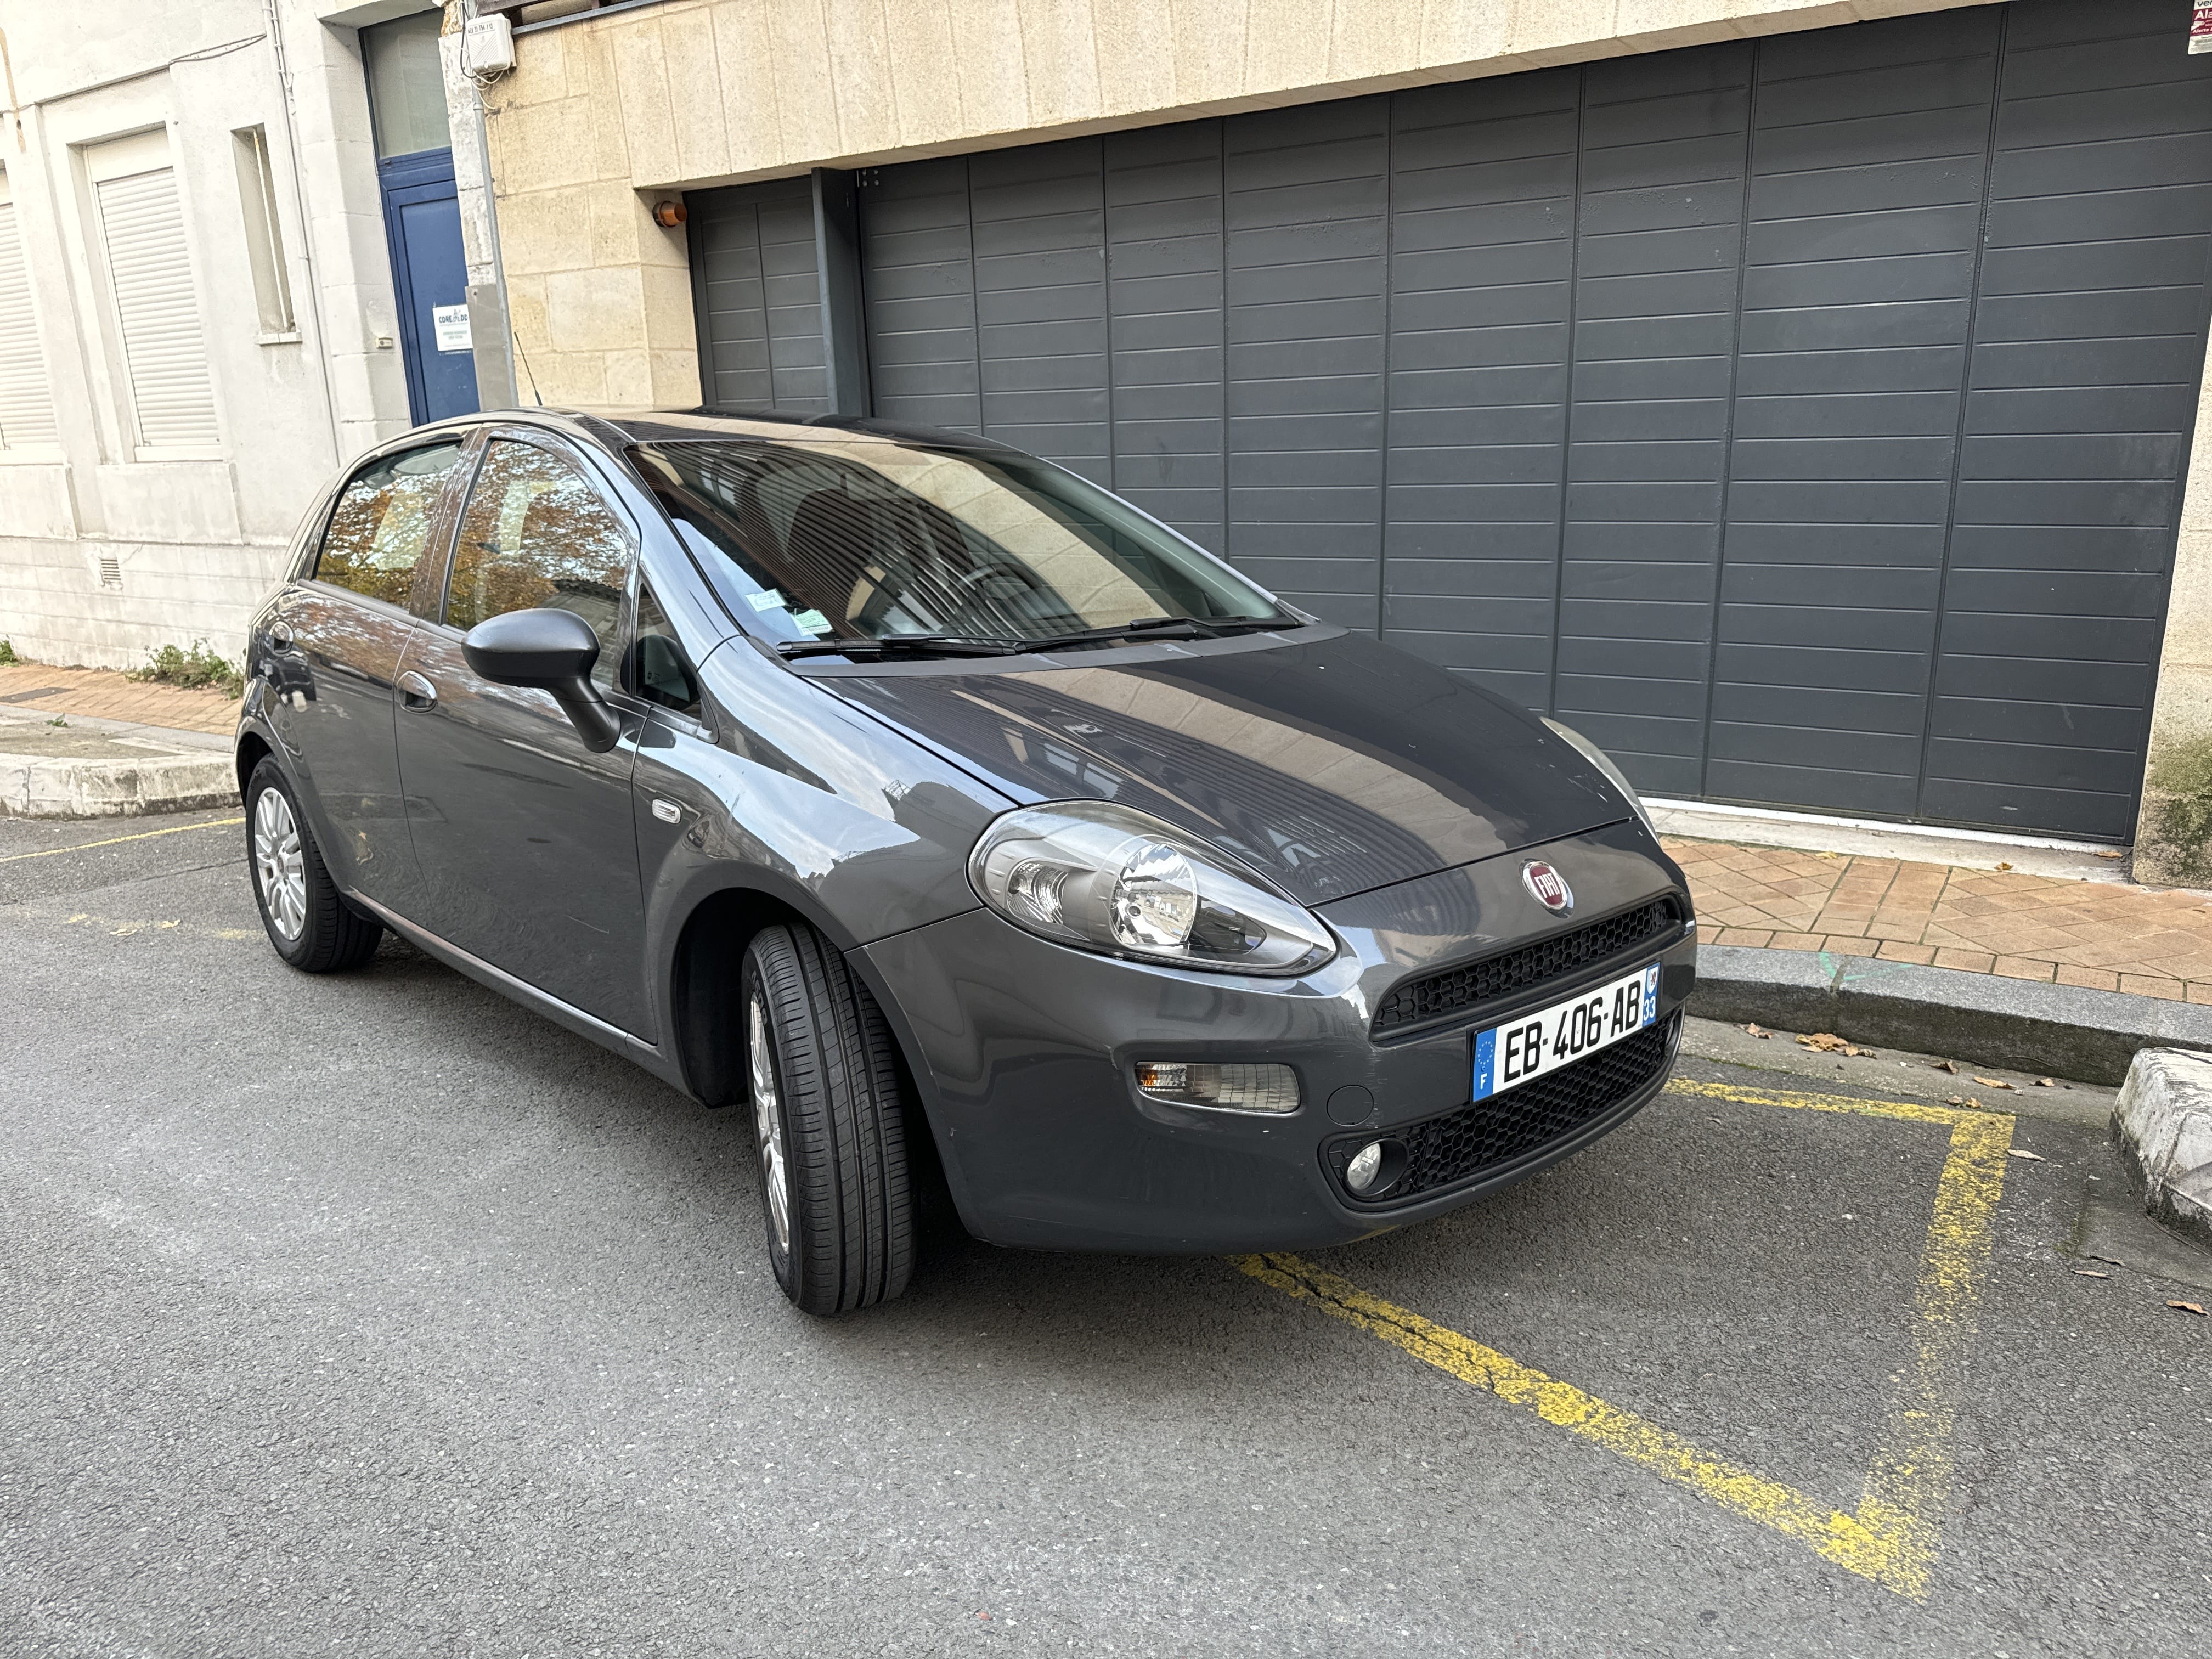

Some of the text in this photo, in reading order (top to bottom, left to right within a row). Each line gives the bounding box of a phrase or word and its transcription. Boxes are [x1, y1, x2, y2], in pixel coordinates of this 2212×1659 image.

[1534, 872, 1560, 899] FIAT
[1480, 980, 1656, 1090] F EB-406-AB 33
